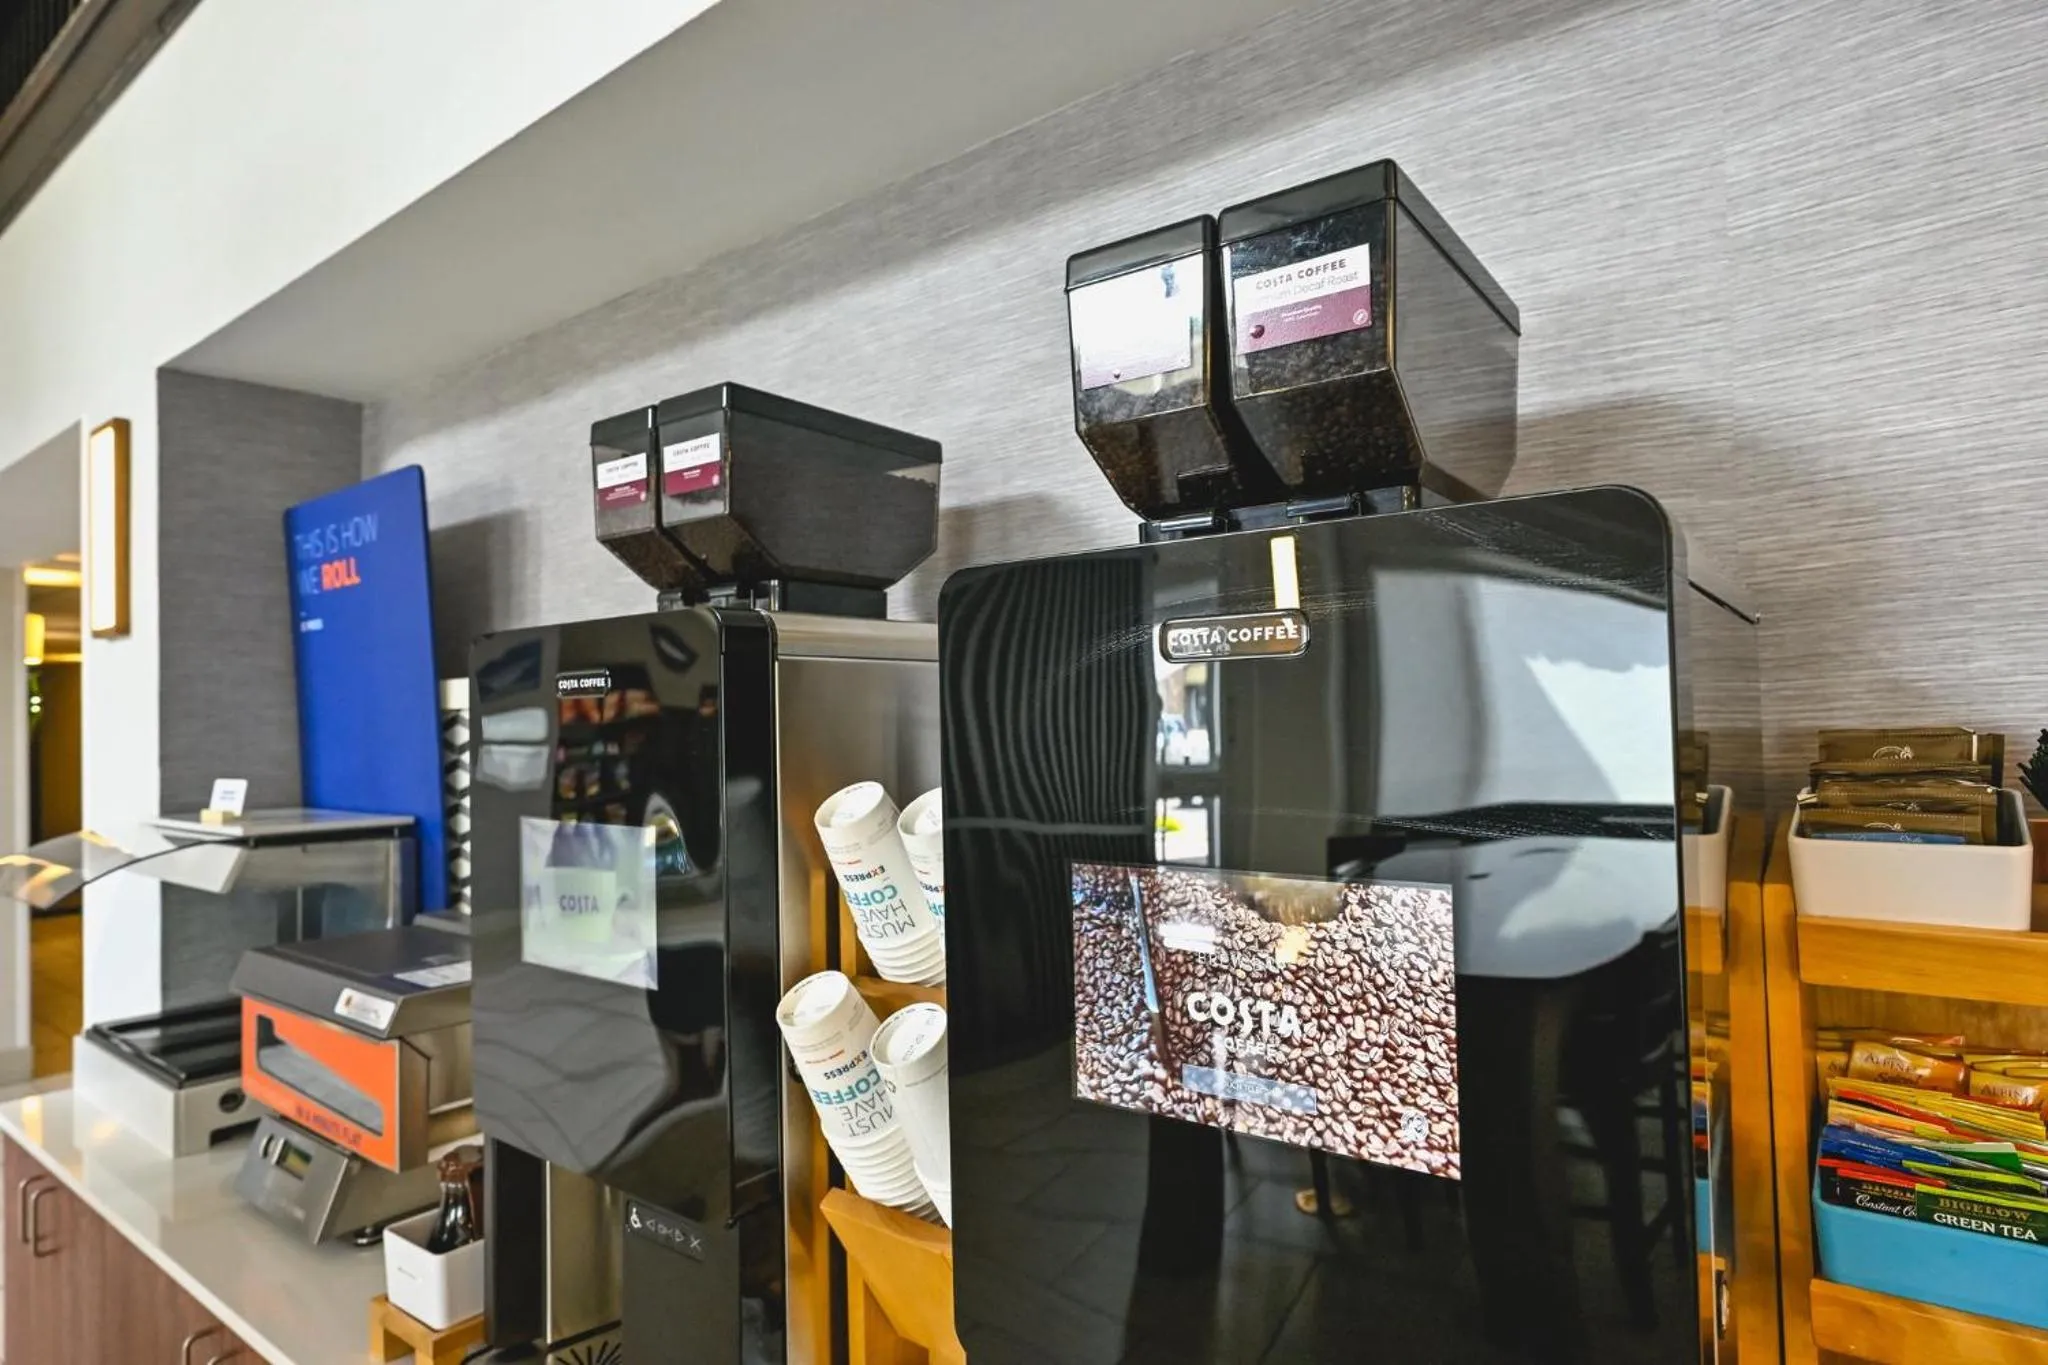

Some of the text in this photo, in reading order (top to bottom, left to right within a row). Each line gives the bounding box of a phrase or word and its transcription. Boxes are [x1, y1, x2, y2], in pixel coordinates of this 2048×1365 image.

[1256, 258, 1347, 290] COSTA COFFEE
[1327, 271, 1359, 286] Roast
[326, 523, 340, 554] IS
[340, 511, 379, 549] HOW
[320, 556, 362, 591] ROLL
[1169, 624, 1300, 647] COSTA COFFEE
[558, 677, 606, 690] COSTA COFFEE
[843, 864, 886, 883] EXPRESS
[559, 894, 600, 915] COSTA
[1187, 991, 1302, 1040] COSTA
[822, 1049, 869, 1081] EXPRESS
[813, 1068, 881, 1106] COFFEE
[1855, 1191, 1900, 1214] Constant
[1902, 1205, 1918, 1218] Co
[1939, 1197, 2031, 1221] BIGELOW
[1933, 1212, 2039, 1241] GREEN TEA
